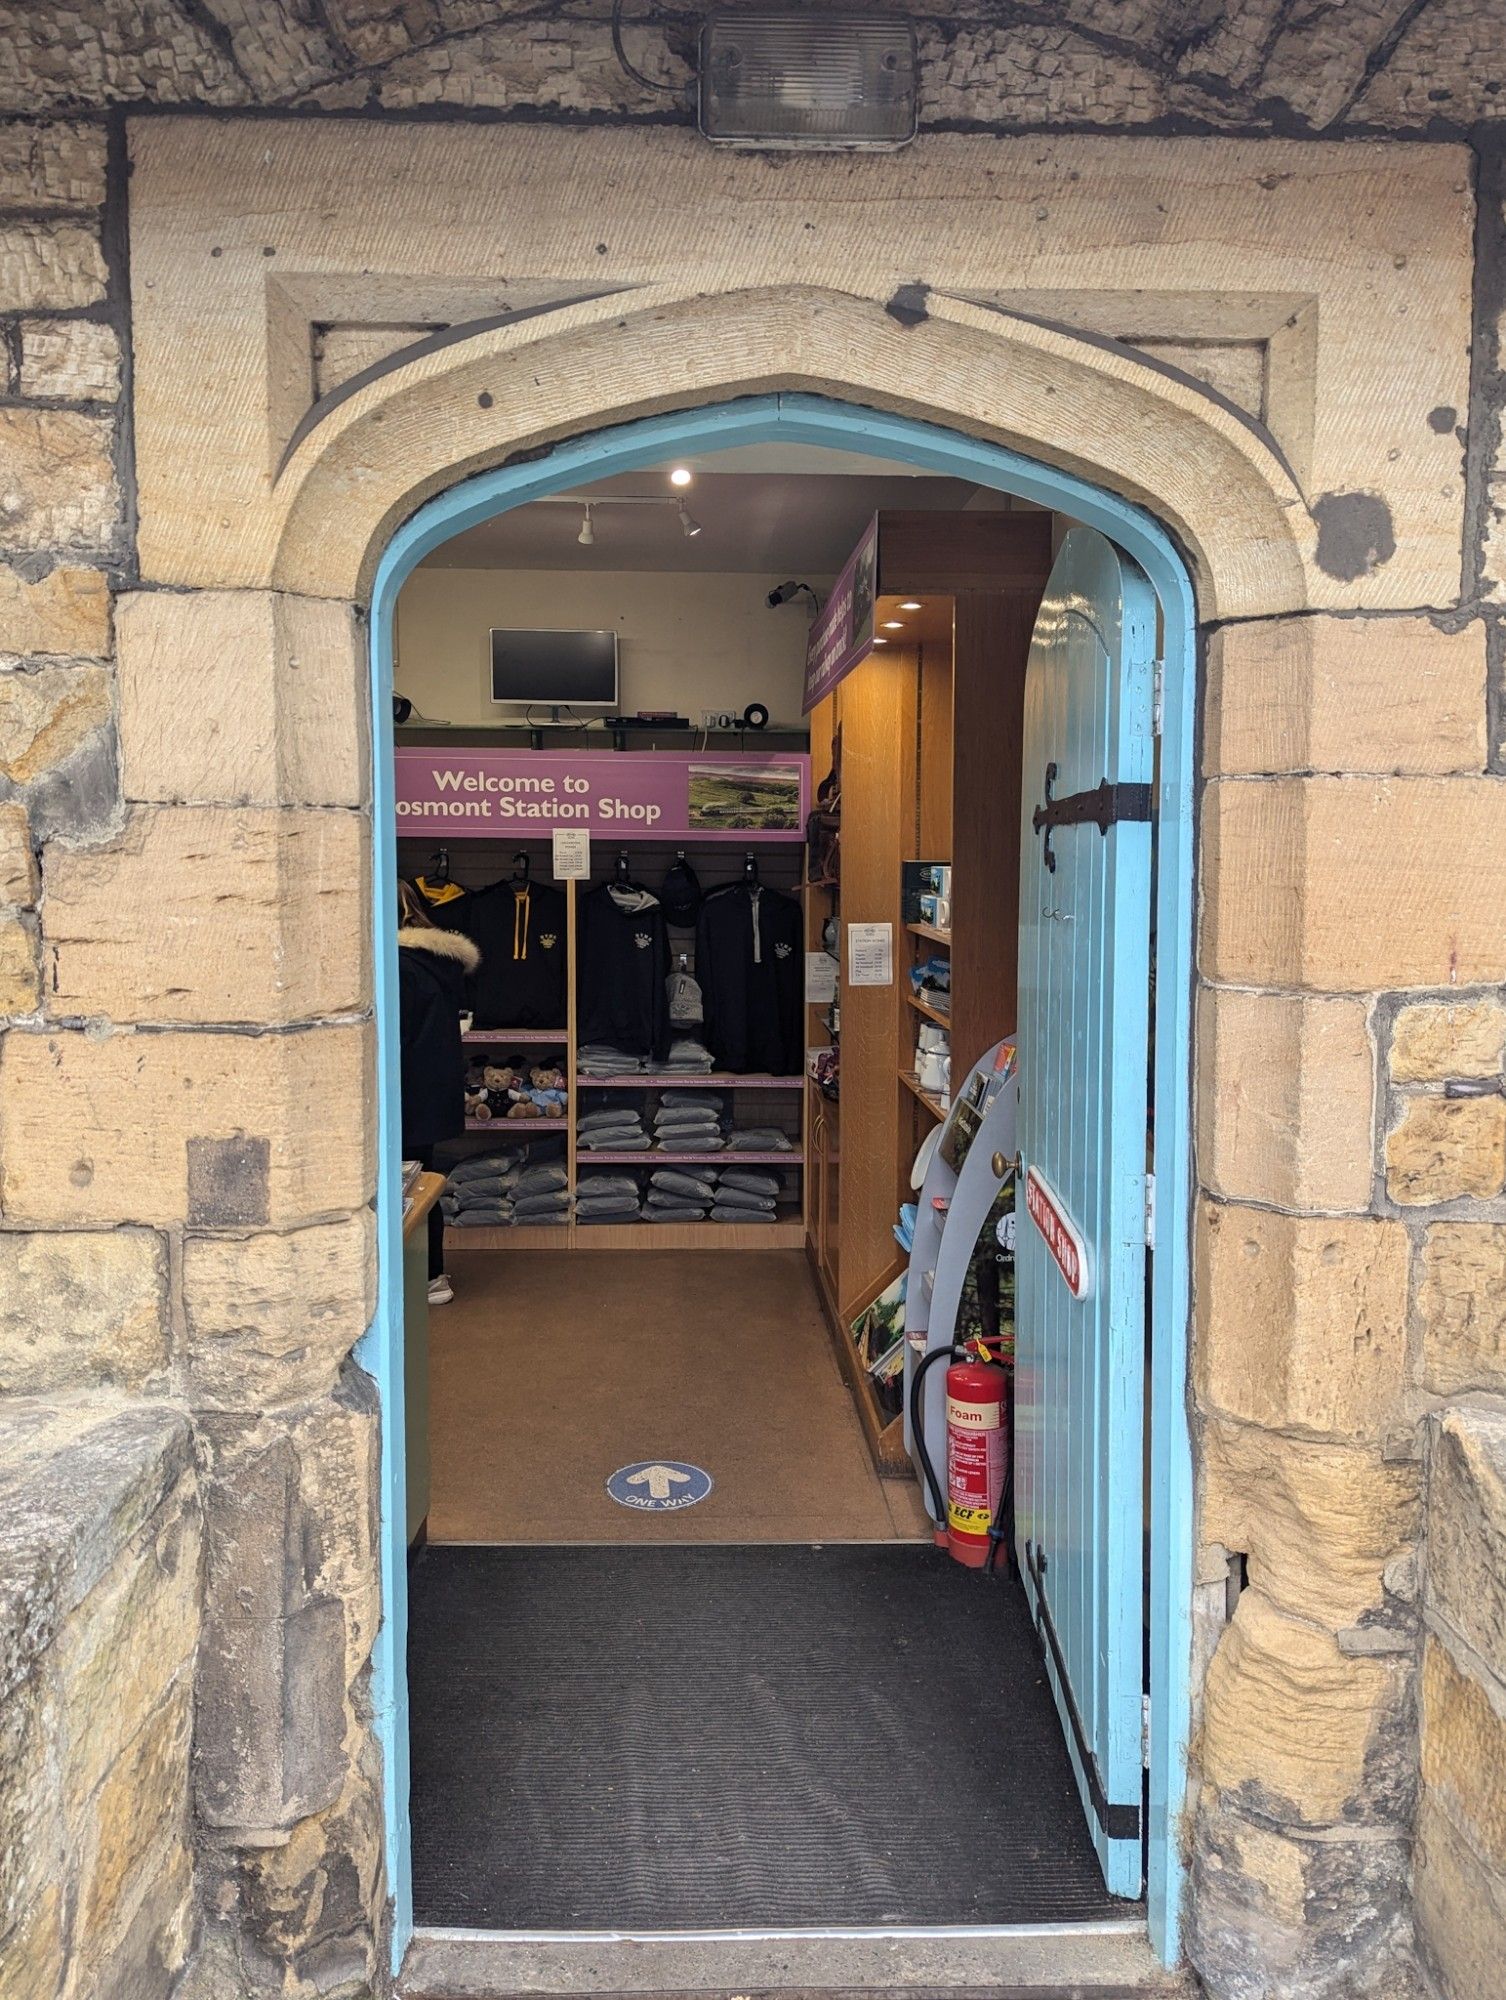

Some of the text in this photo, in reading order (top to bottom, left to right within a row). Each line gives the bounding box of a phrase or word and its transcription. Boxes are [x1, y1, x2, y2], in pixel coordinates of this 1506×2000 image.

[432, 770, 590, 794] Welcome to
[395, 796, 661, 824] osmont Station Shop
[1027, 1177, 1055, 1246] STATION
[996, 1253, 1015, 1263] Ordn
[950, 1405, 982, 1422] Foam
[624, 1494, 696, 1508] ONE WAY
[954, 1506, 975, 1520] ECF
